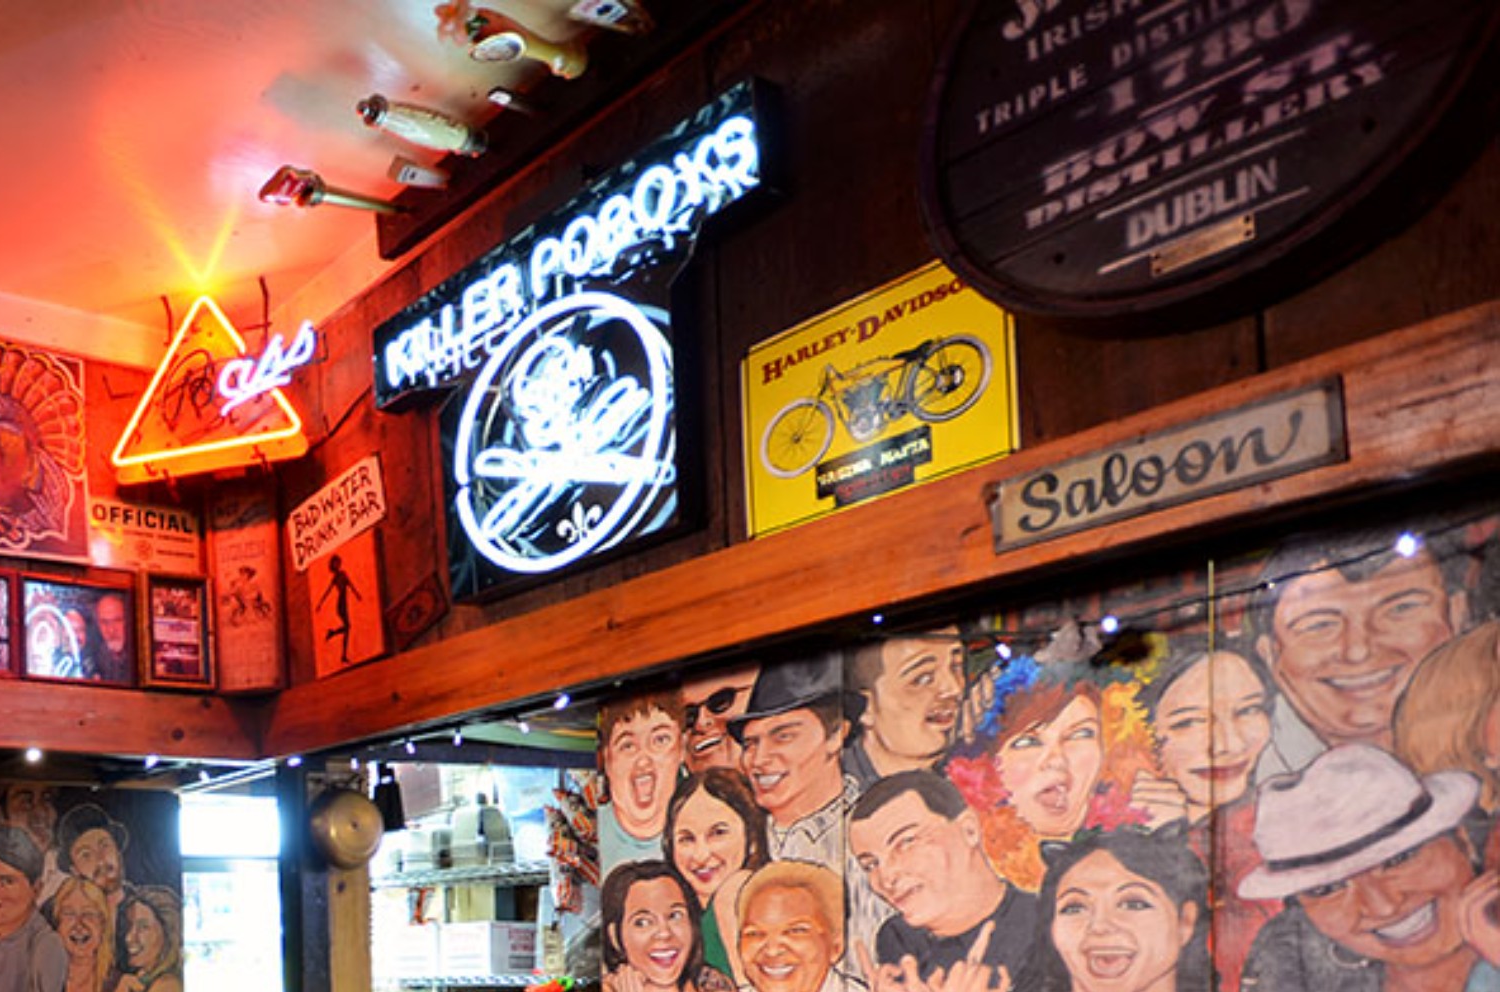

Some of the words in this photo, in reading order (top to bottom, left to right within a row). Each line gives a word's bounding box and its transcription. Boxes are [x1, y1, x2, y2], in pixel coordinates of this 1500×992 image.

[975, 64, 1088, 134] TRIPLE
[1111, 0, 1235, 68] DISTIL
[1024, 52, 1396, 230] DISTILLERY
[1126, 157, 1279, 249] DUBLIN
[385, 262, 524, 388] KILLER
[761, 277, 969, 386] HARLEY-DAVIDSO
[91, 503, 194, 534] OFFICIAL
[348, 490, 381, 529] BAR
[1018, 409, 1304, 534] Saloon
